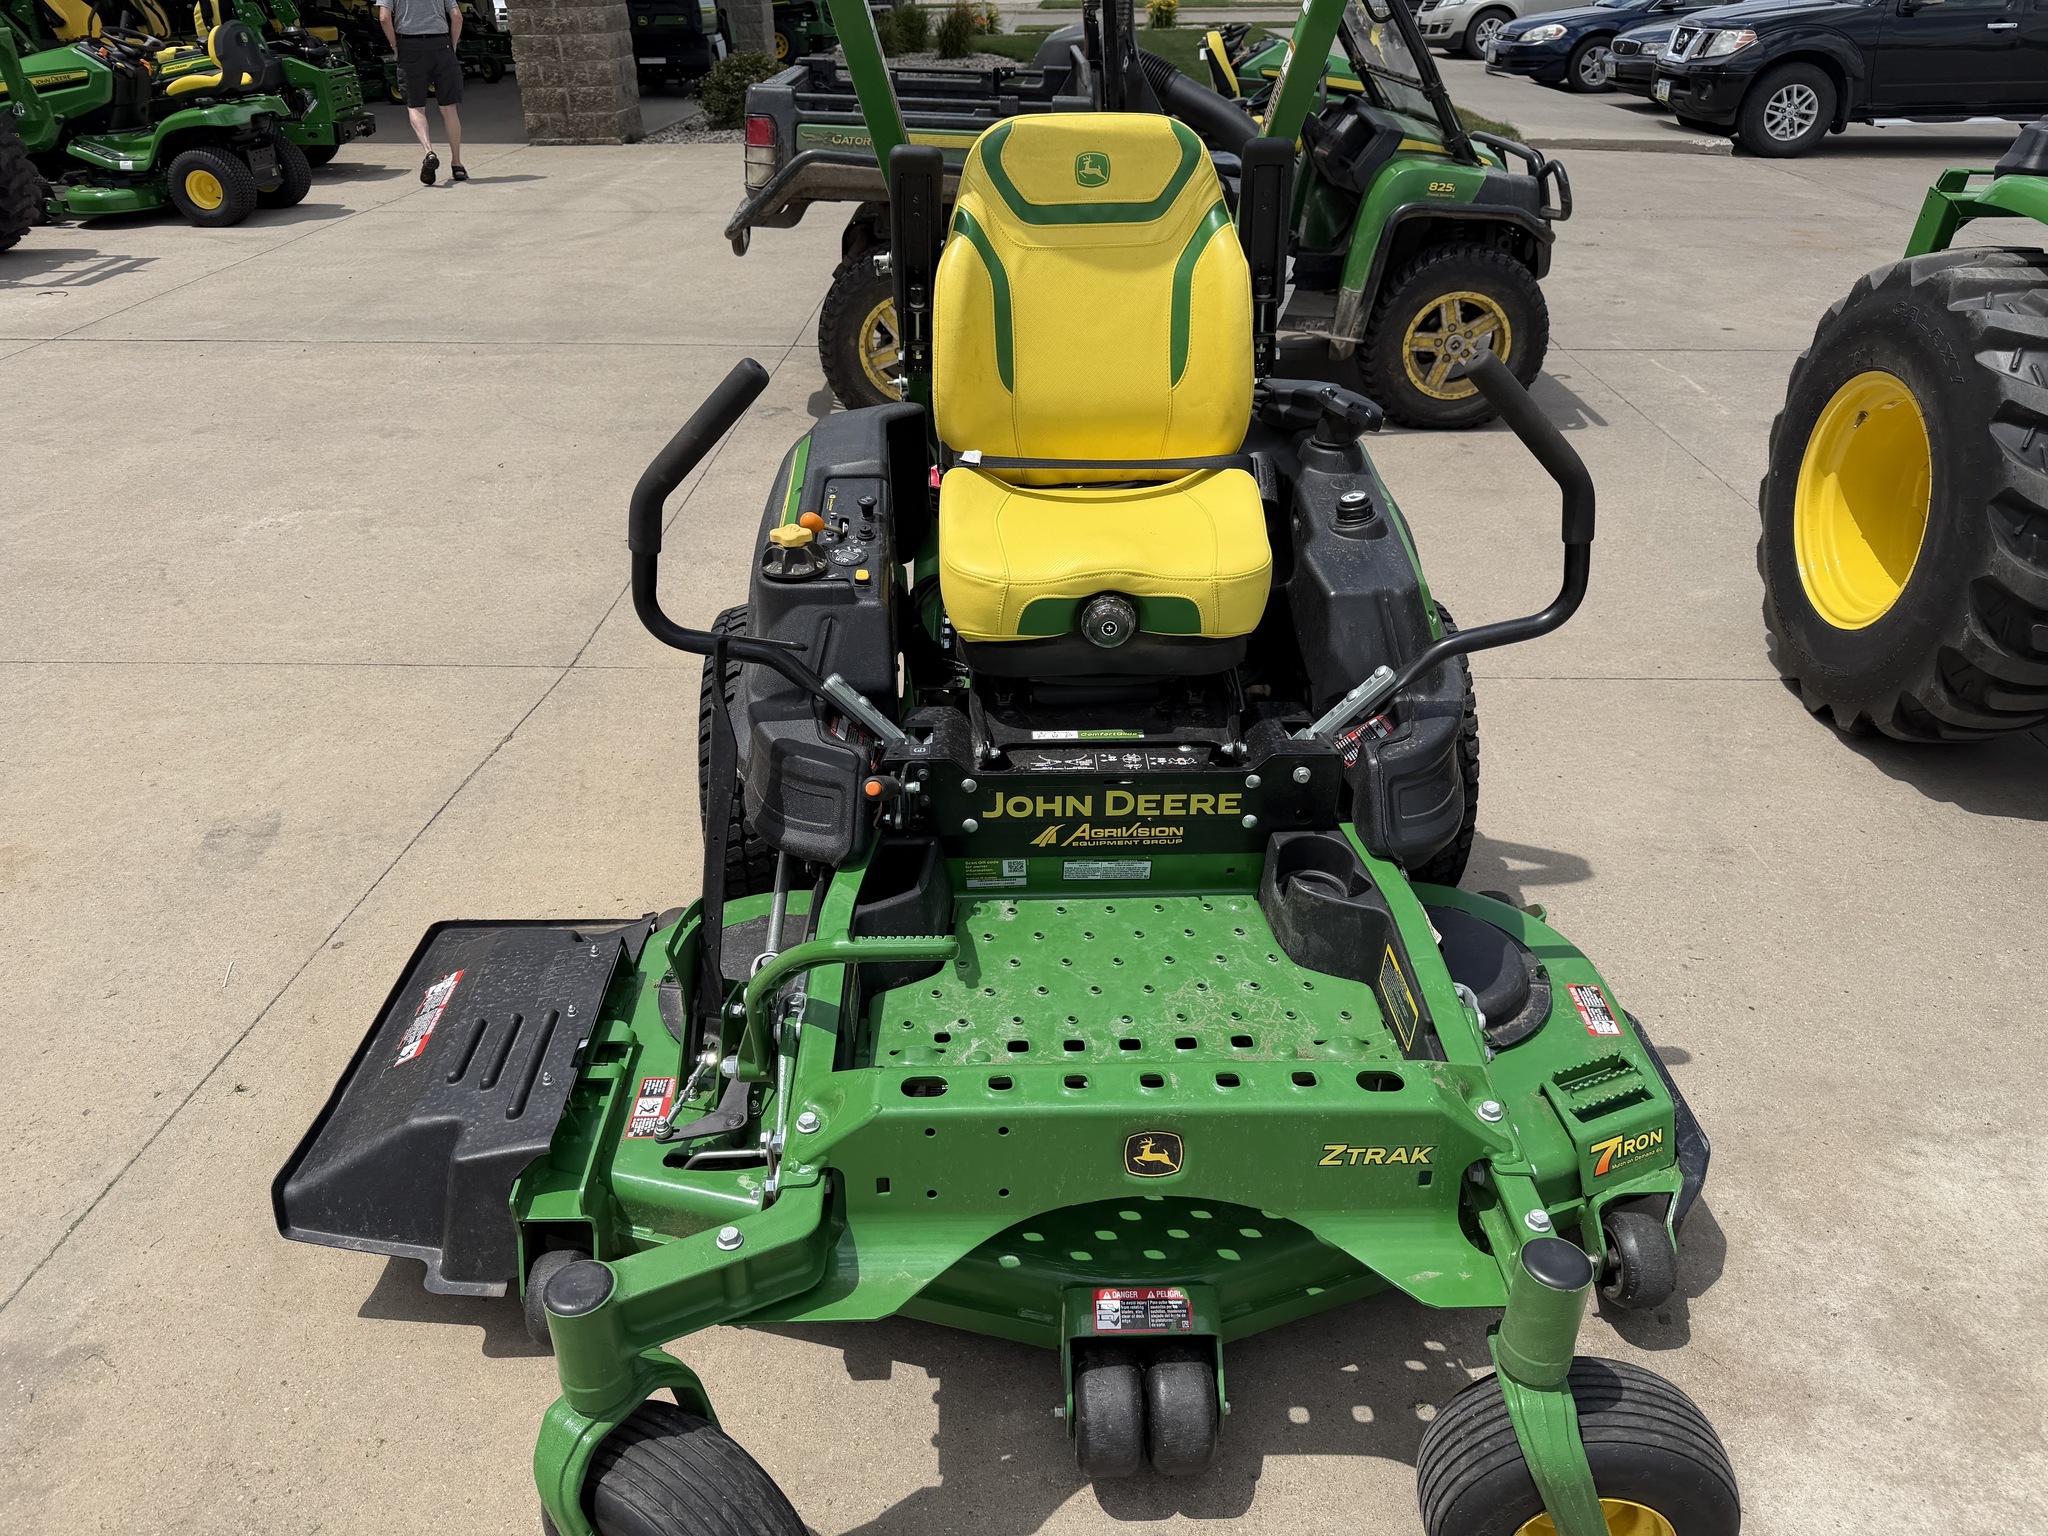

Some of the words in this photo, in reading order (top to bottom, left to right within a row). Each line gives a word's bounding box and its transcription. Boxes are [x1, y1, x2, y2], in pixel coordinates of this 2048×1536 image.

[50, 74, 71, 82] DEERE
[832, 135, 872, 146] GATOR
[982, 792, 1093, 818] JOHN
[1105, 790, 1242, 816] DEERE
[1143, 838, 1183, 846] GROUP
[1318, 1144, 1435, 1166] ZTRAK
[1634, 1150, 1655, 1162] Demand
[1112, 1290, 1138, 1299] DANGER
